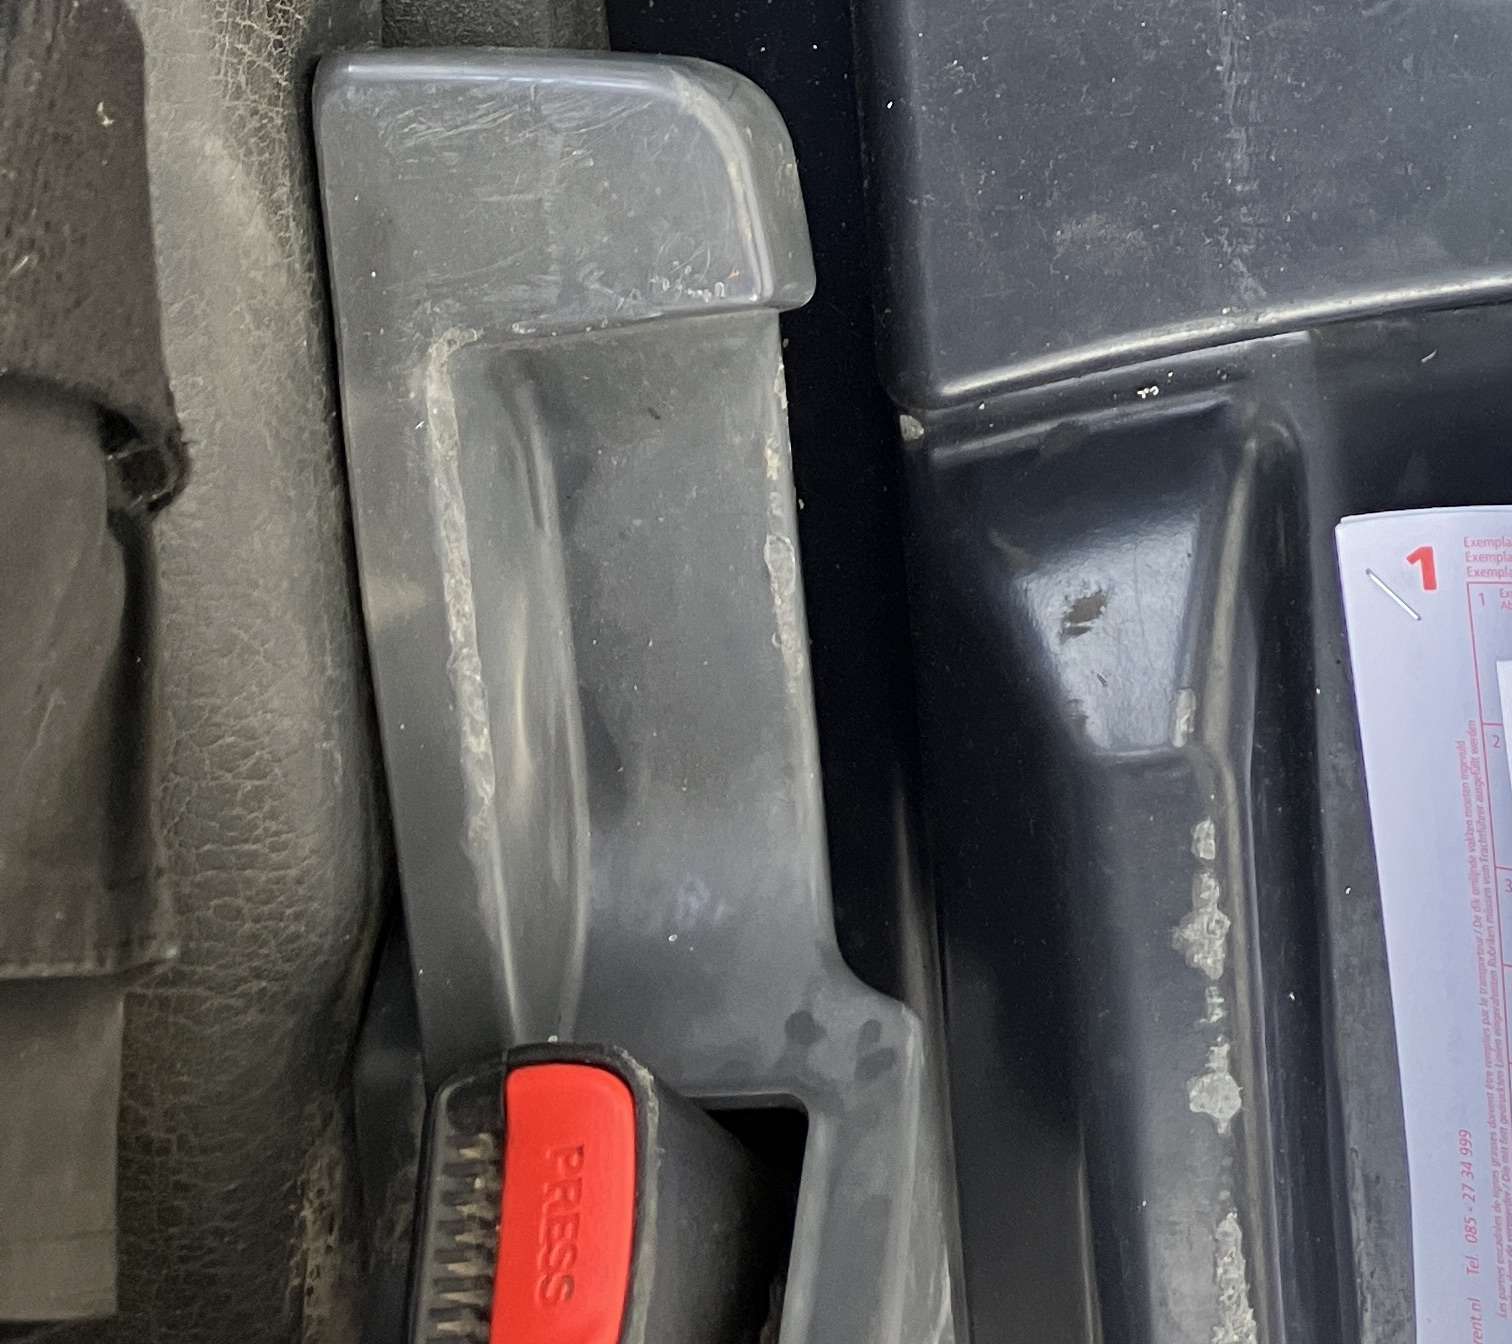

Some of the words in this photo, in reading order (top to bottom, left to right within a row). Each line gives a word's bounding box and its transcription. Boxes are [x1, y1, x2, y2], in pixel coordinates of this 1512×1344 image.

[1406, 546, 1438, 591] 1
[1458, 1129, 1473, 1158] 999
[1459, 1161, 1474, 1181] 34
[1461, 1184, 1476, 1203] 27
[535, 1143, 585, 1306] PRESS
[1463, 1216, 1478, 1244] 085
